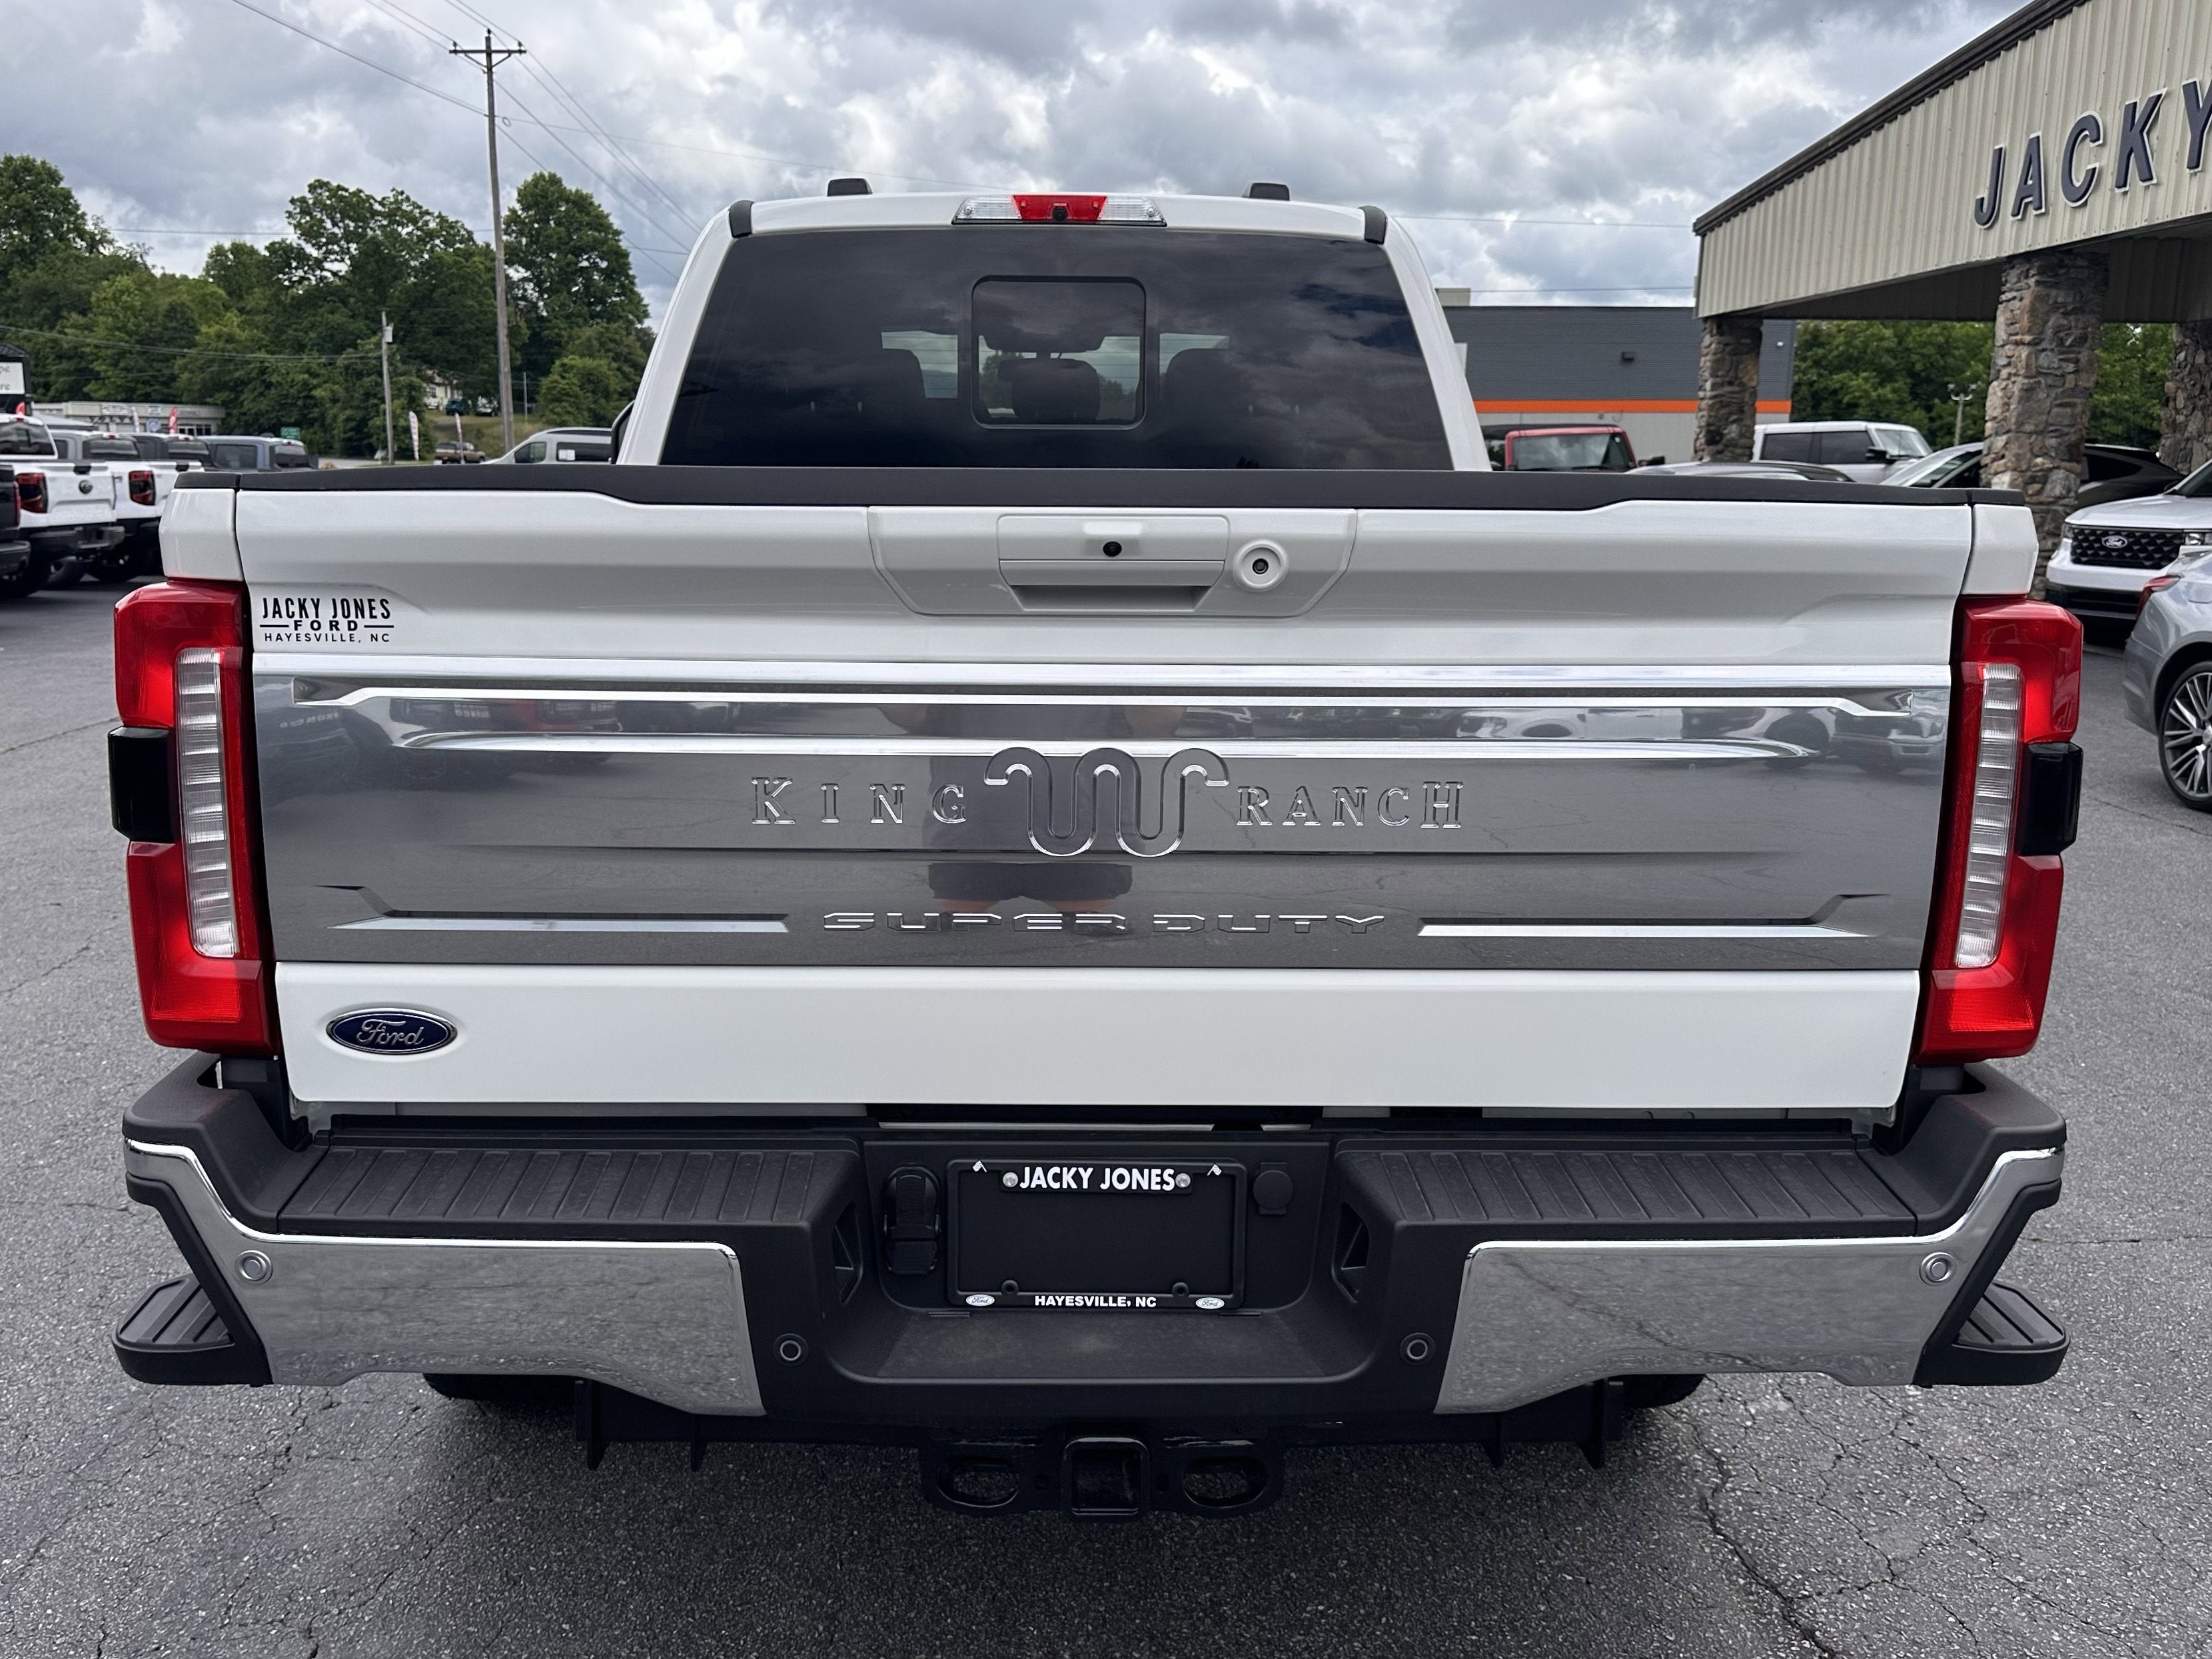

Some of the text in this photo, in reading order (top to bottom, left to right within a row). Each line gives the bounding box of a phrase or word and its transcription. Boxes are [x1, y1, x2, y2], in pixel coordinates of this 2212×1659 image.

[1973, 78, 2212, 229] JACKY
[263, 598, 390, 620] JACKY JONES
[294, 620, 358, 632] FORD
[265, 633, 390, 644] HAYESVILLE, NC
[752, 777, 1463, 828] KING RANCH
[824, 912, 1385, 933] SUPER DUTY
[356, 1019, 425, 1045] Ford
[1019, 1167, 1175, 1191] JACKY JONES
[1035, 1295, 1157, 1307] HAYESVILLE, NC
